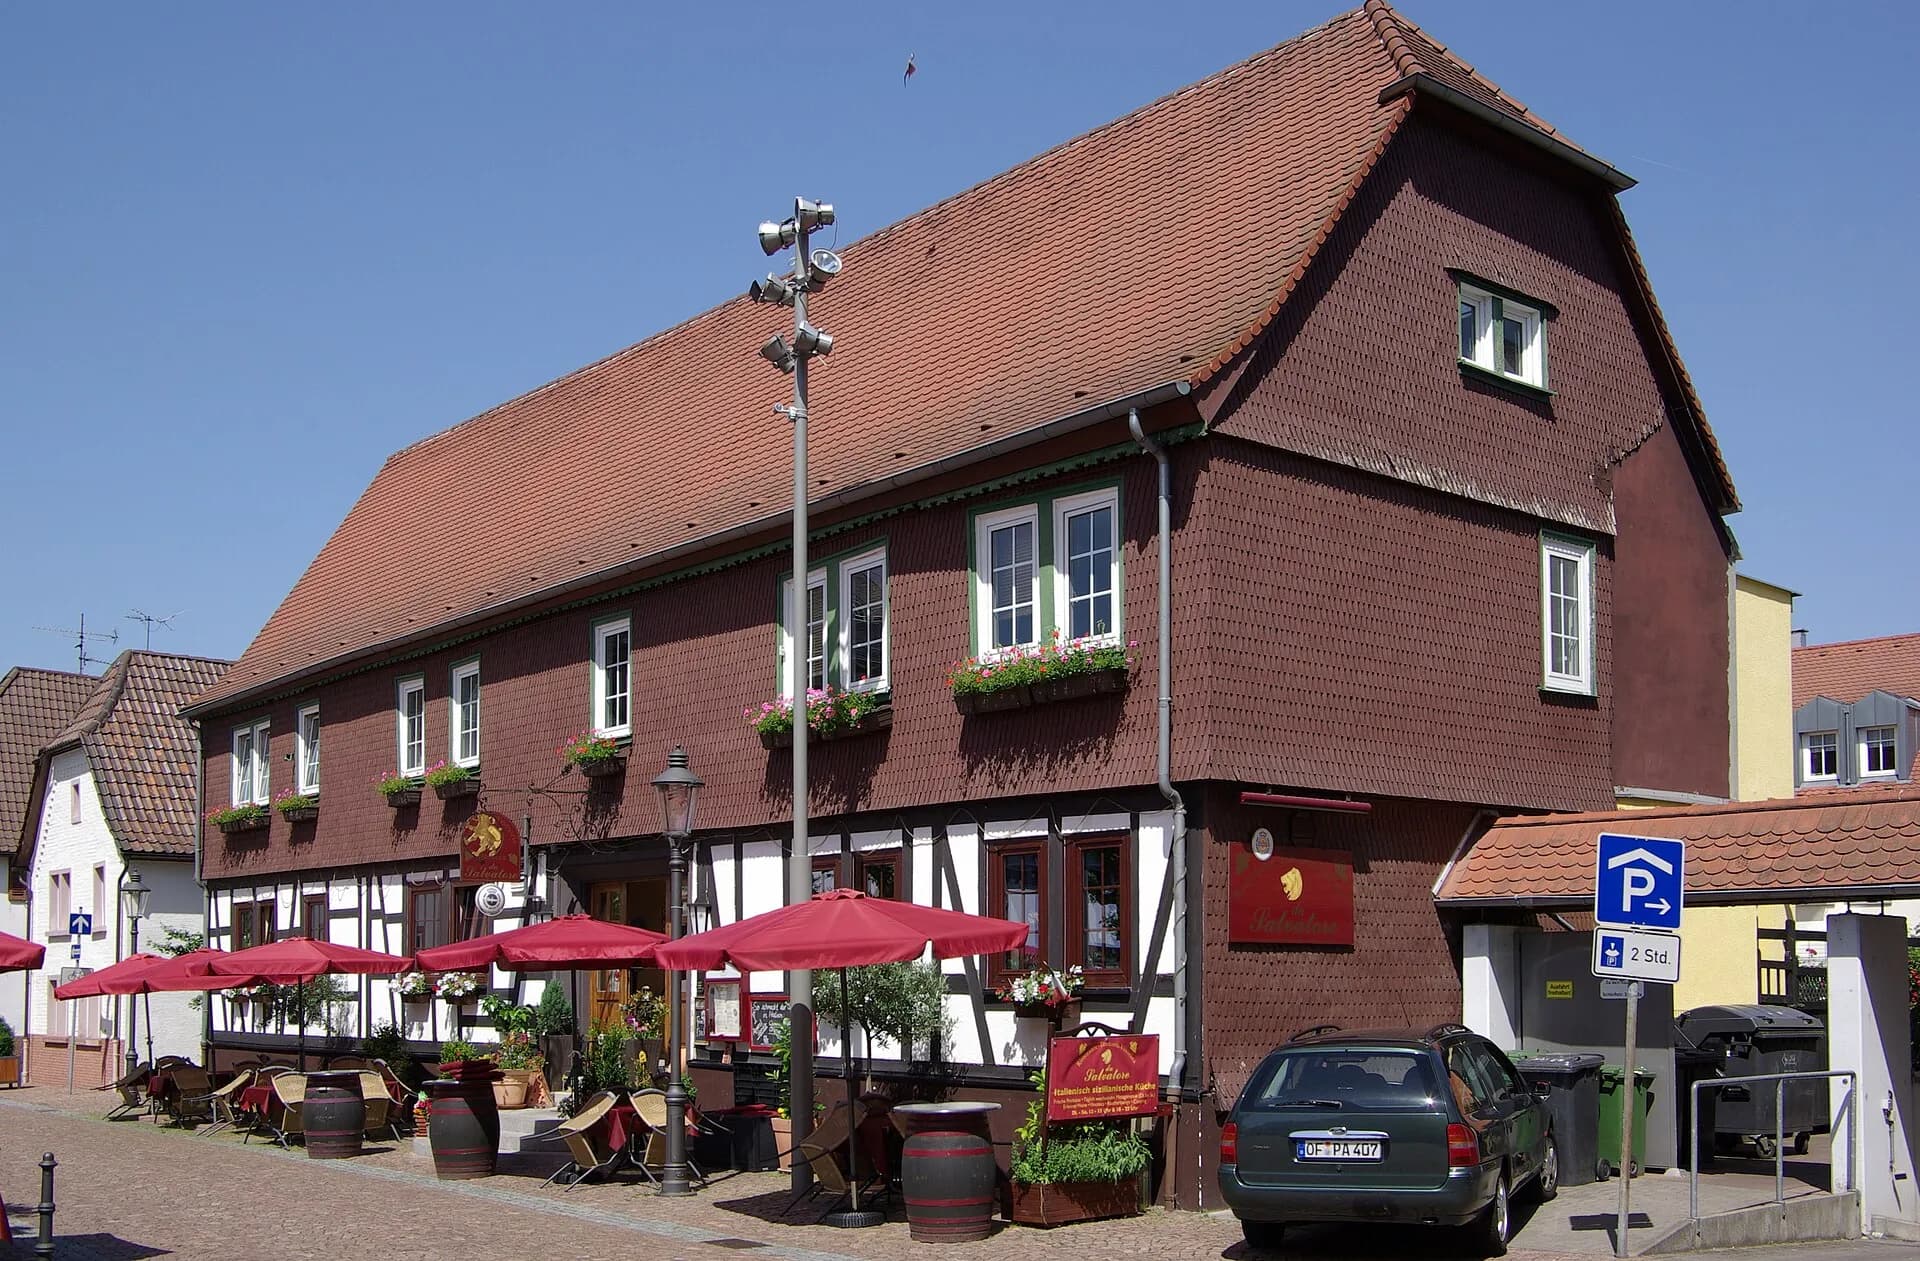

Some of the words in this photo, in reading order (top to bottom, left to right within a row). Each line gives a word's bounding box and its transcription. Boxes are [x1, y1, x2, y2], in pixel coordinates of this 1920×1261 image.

[1622, 867, 1656, 912] P
[1249, 907, 1337, 936] Salvatore
[1631, 947, 1640, 961] 2
[1644, 948, 1671, 965] Std.
[1084, 1068, 1130, 1082] Salvatore
[1054, 1086, 1091, 1097] Italienisch
[1092, 1083, 1133, 1094] sizilianische
[1134, 1080, 1156, 1091] Küche
[1306, 1142, 1322, 1156] OF
[1333, 1142, 1350, 1156] PA
[1353, 1142, 1378, 1157] 407
